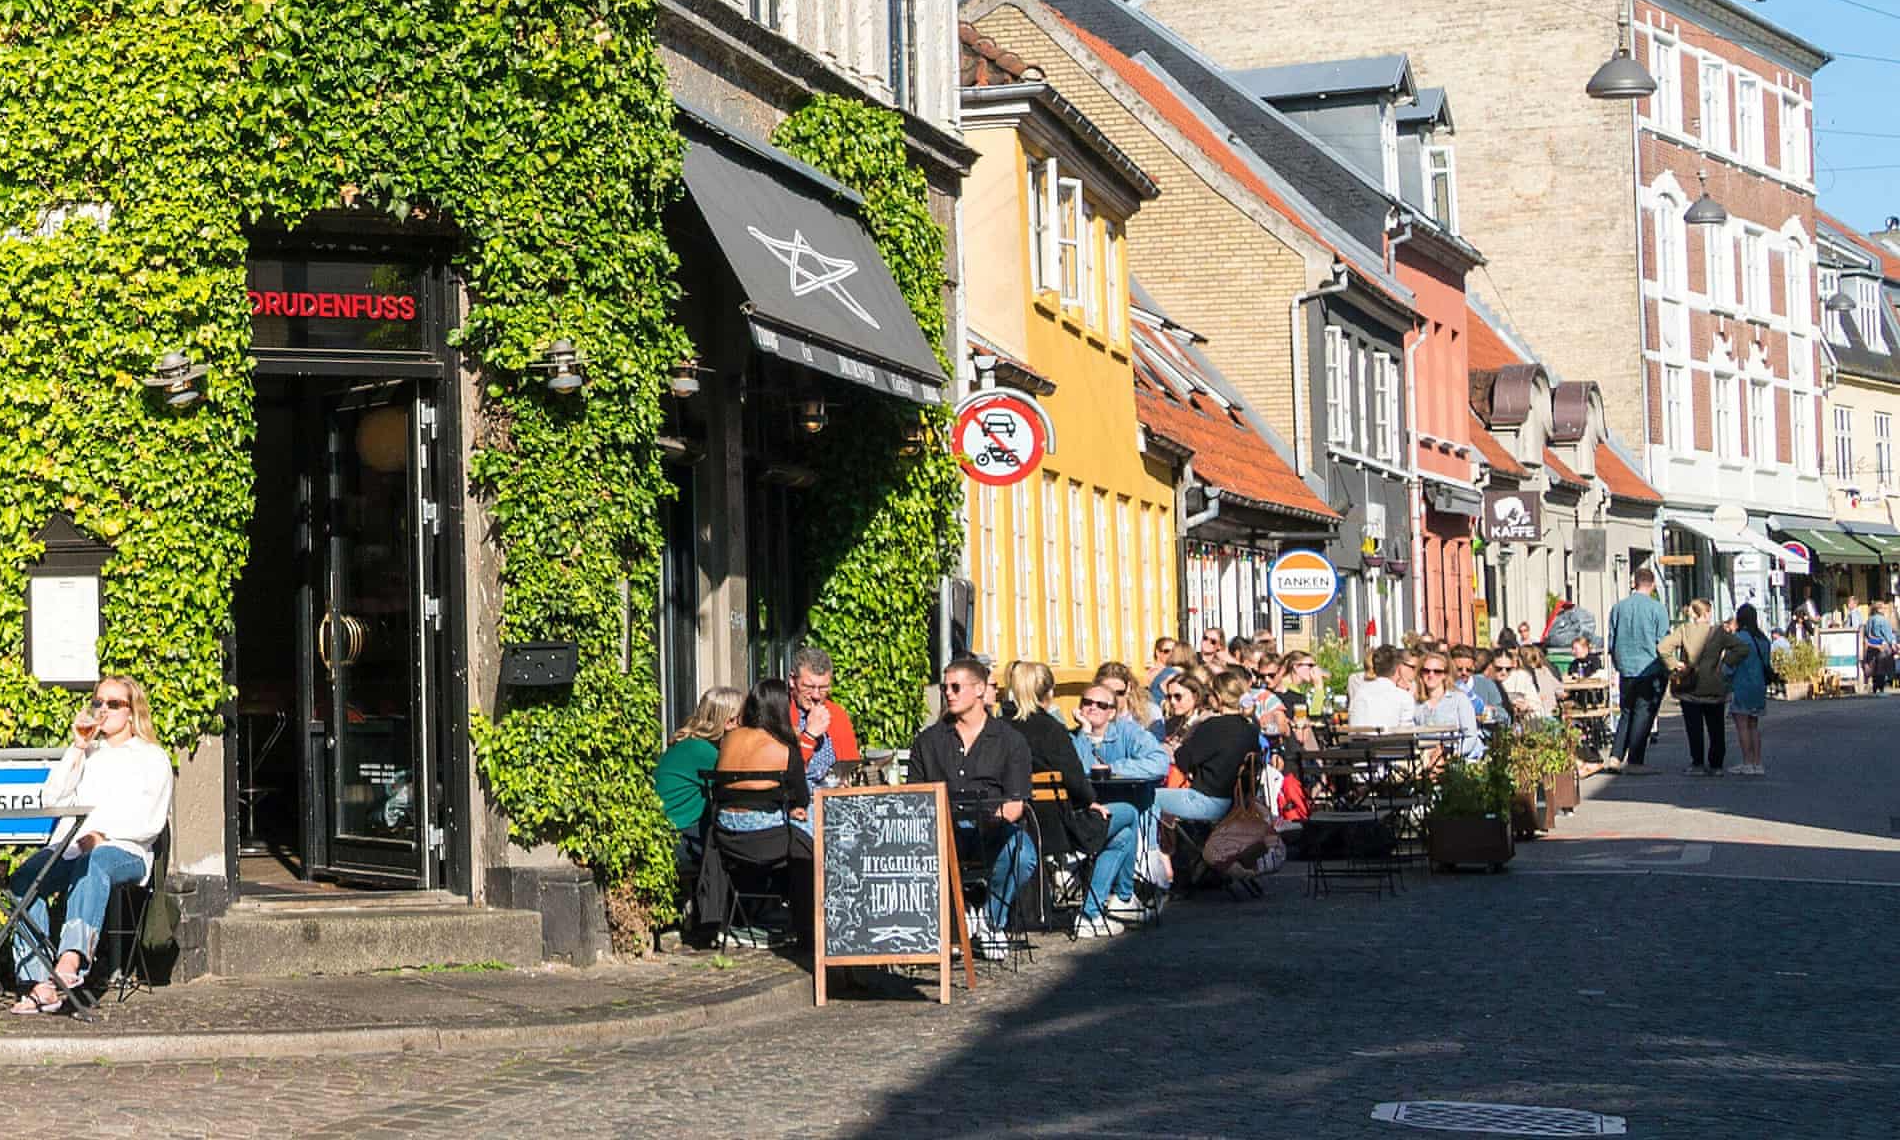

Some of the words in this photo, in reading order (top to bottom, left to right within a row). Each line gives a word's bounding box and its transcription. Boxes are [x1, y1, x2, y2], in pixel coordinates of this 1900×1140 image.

[247, 290, 416, 321] DRUDENFUSS
[1490, 525, 1535, 538] KAFFE
[1277, 576, 1330, 588] TANKEN
